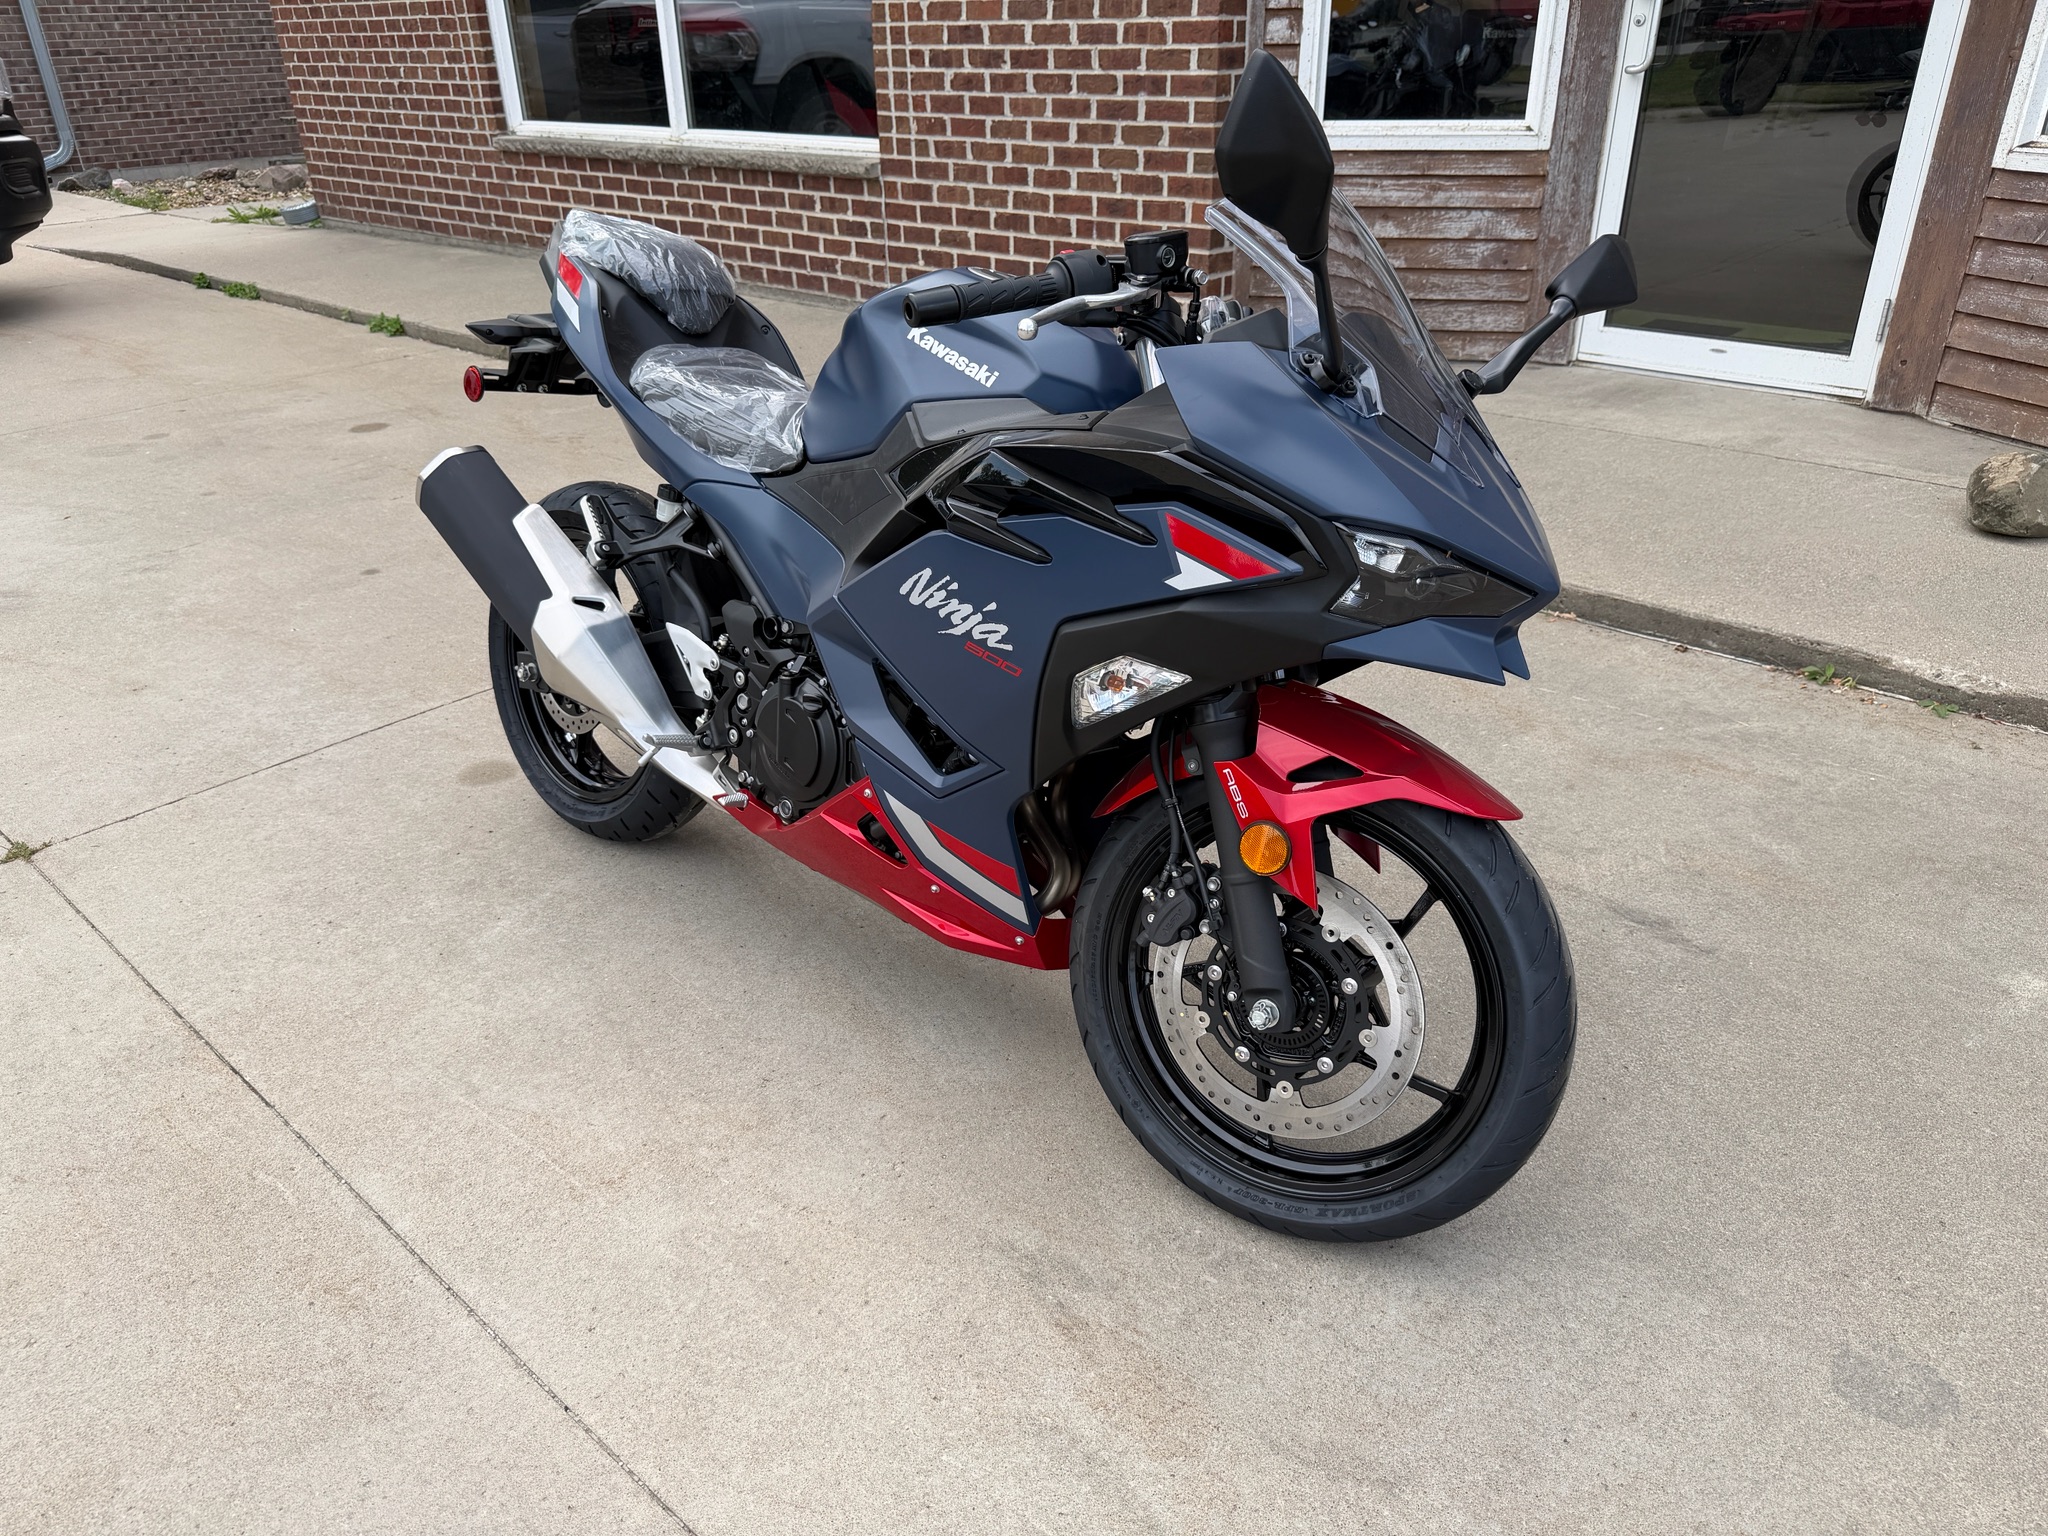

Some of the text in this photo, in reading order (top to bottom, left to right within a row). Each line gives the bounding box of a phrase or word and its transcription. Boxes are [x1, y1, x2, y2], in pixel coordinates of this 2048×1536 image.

[906, 326, 1000, 388] Kawasaki
[899, 567, 1014, 651] Ninja
[964, 641, 1023, 677] 500
[1222, 768, 1249, 819] ABS
[1314, 1190, 1419, 1218] SPORTMAX
